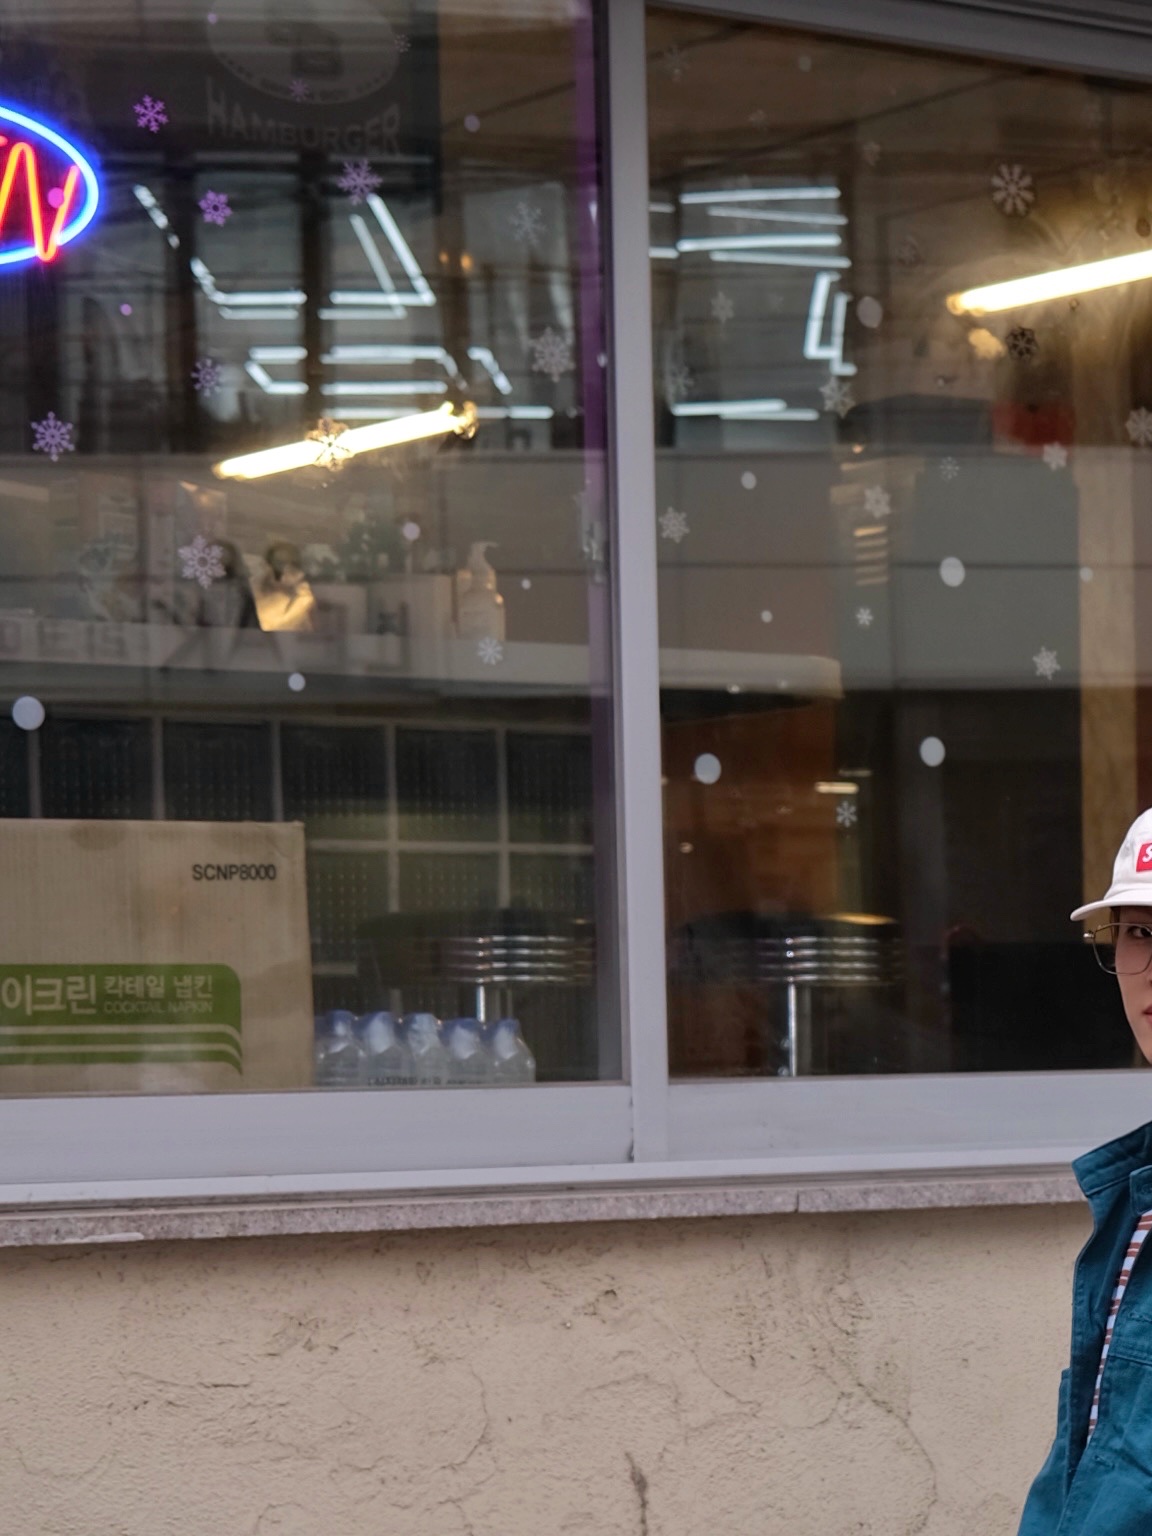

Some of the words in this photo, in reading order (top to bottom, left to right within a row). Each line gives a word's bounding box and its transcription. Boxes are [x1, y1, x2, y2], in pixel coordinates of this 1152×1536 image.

[192, 864, 276, 881] SCNP8000
[104, 975, 165, 998] 칵테일
[174, 975, 212, 998] 냅킨
[104, 1002, 163, 1013] COCKTAIL
[169, 1002, 212, 1013] NAPKIN
